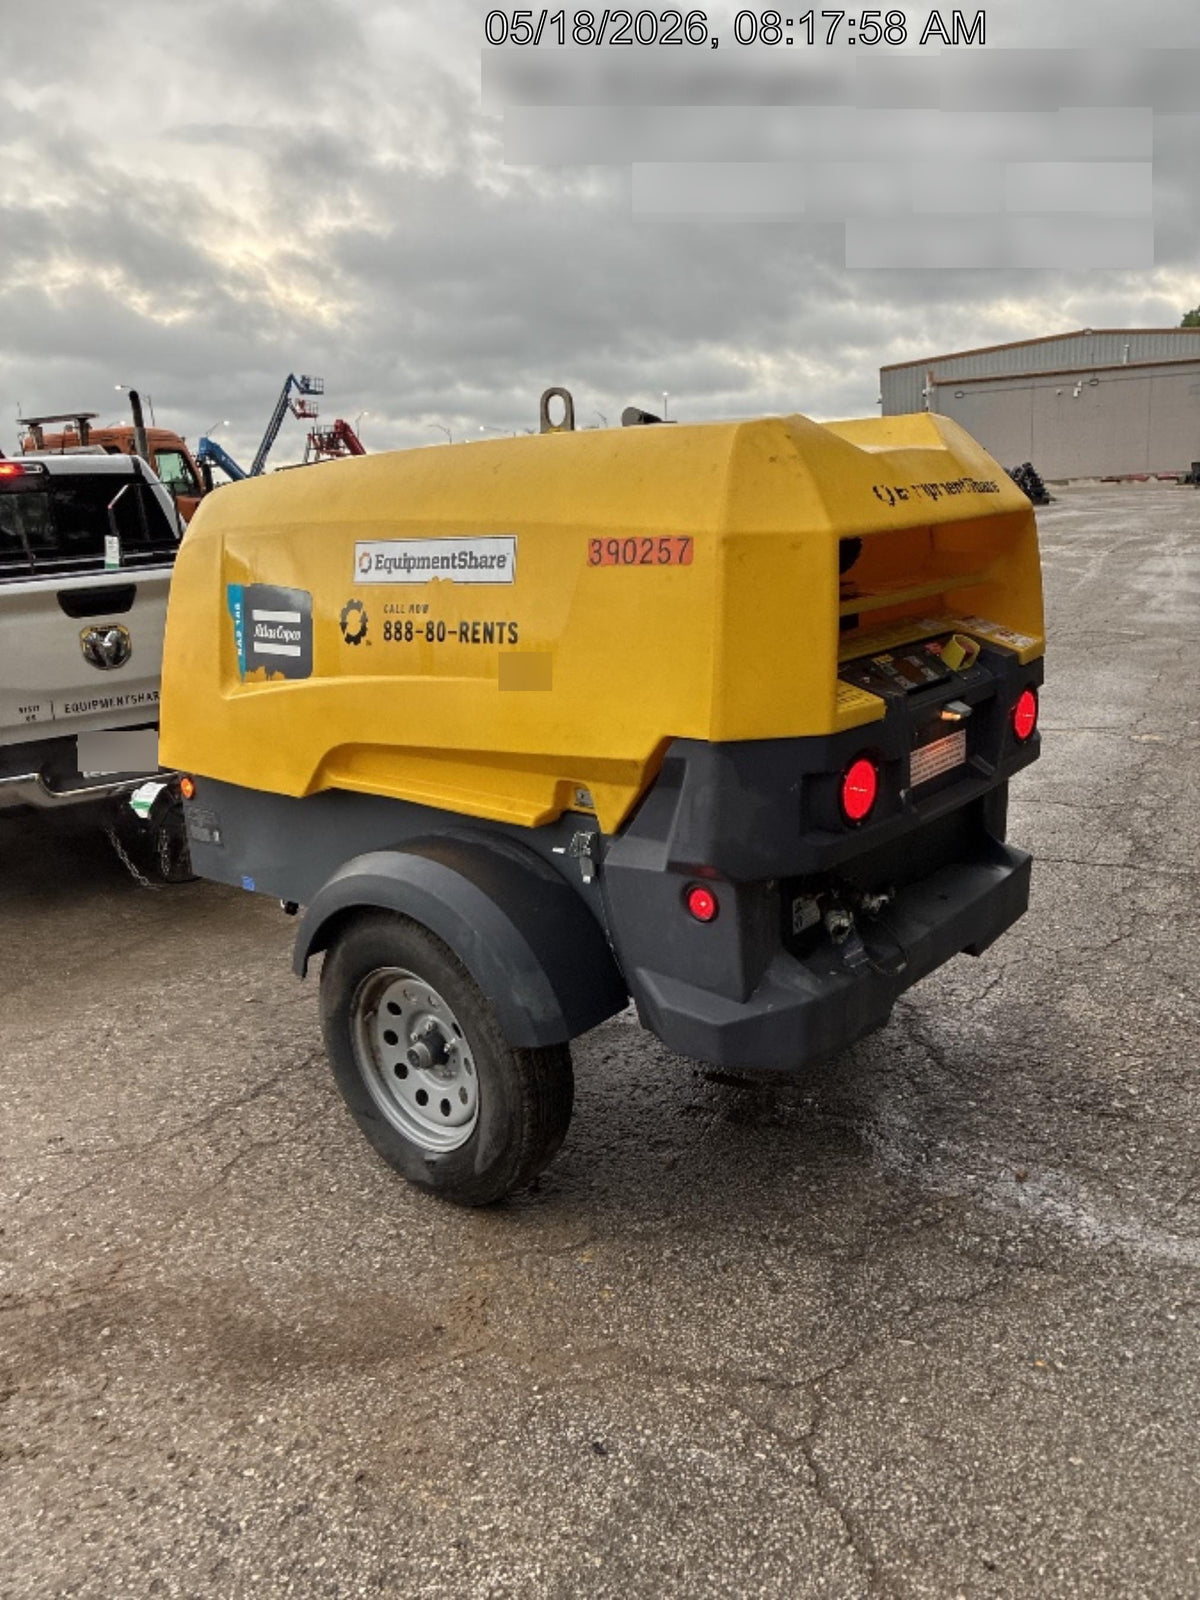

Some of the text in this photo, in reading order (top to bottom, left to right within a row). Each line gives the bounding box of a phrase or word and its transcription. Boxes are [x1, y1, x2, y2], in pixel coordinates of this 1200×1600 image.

[374, 551, 507, 574] EquipmentShare
[590, 537, 690, 566] 390257
[383, 603, 429, 614] CALL NOW
[383, 620, 518, 644] 888-80-RENTS
